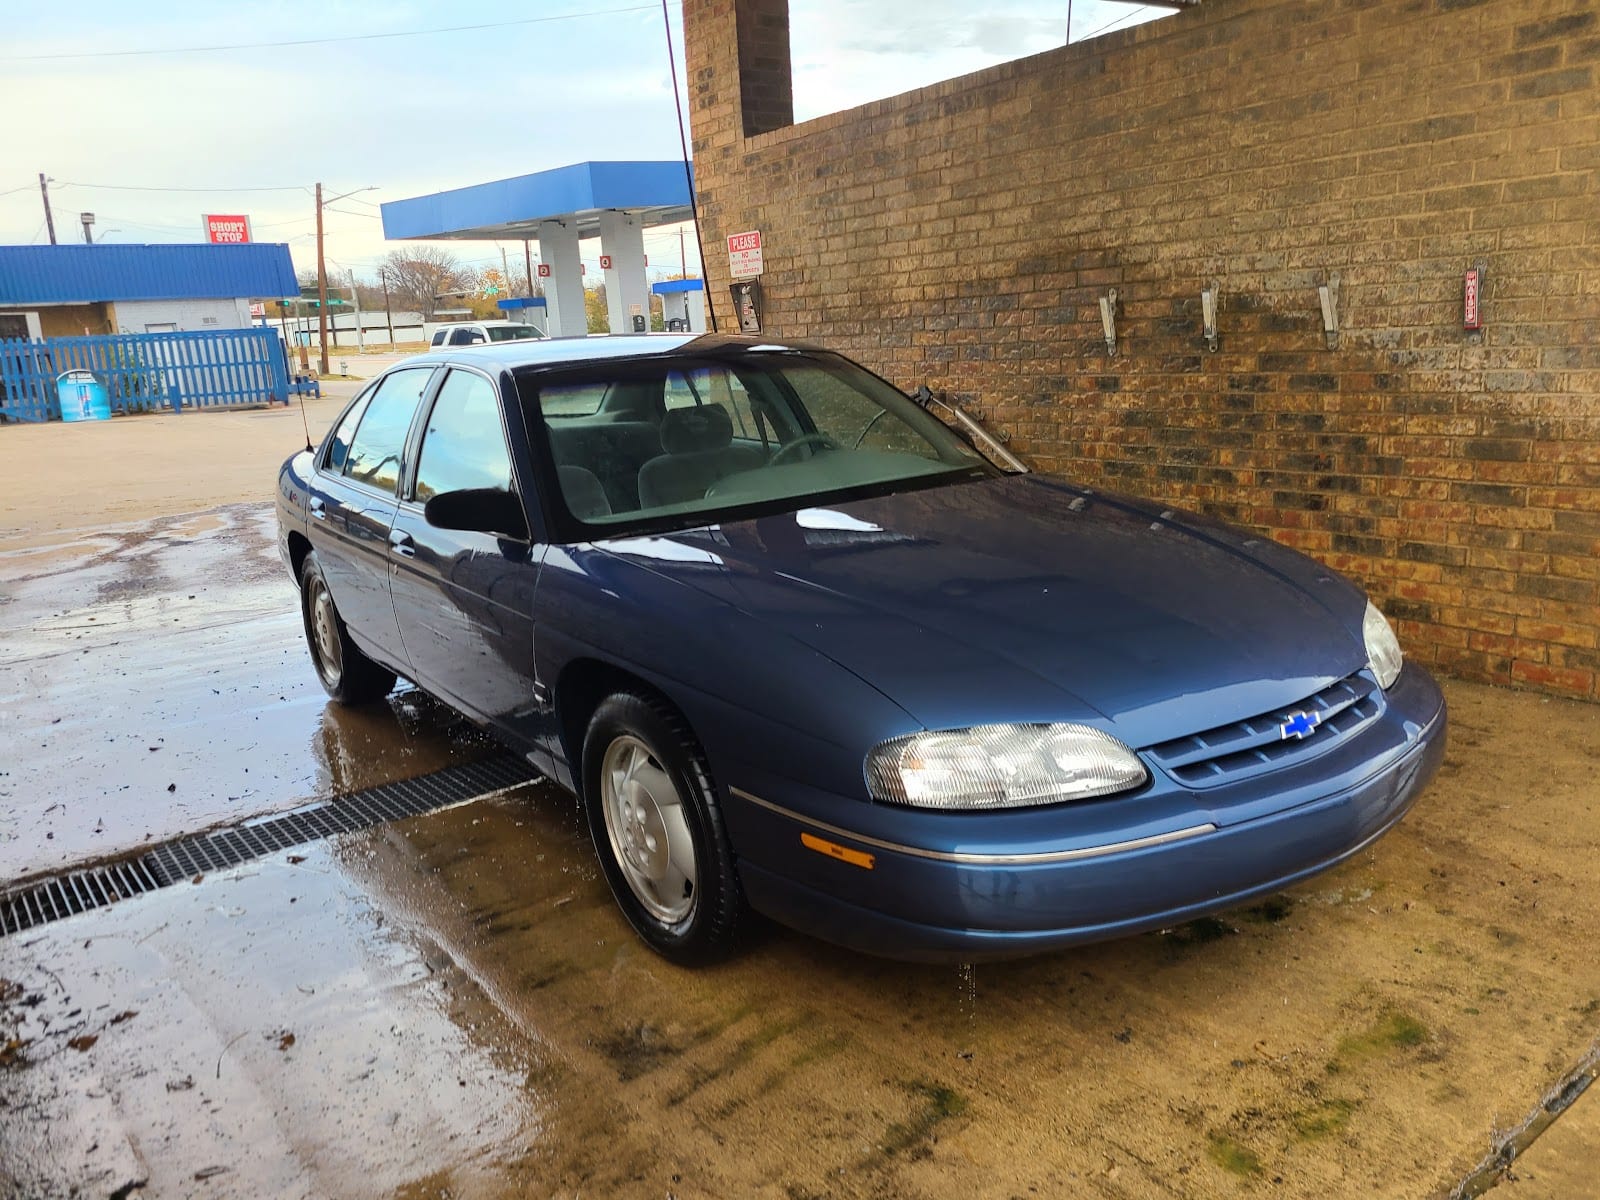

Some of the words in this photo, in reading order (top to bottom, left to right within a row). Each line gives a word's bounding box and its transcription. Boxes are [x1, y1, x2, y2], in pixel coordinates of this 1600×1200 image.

[210, 222, 245, 232] SHORT
[215, 232, 243, 242] STOP
[732, 235, 757, 250] PLEASE
[741, 251, 749, 259] NO
[1467, 279, 1475, 307] MATS
